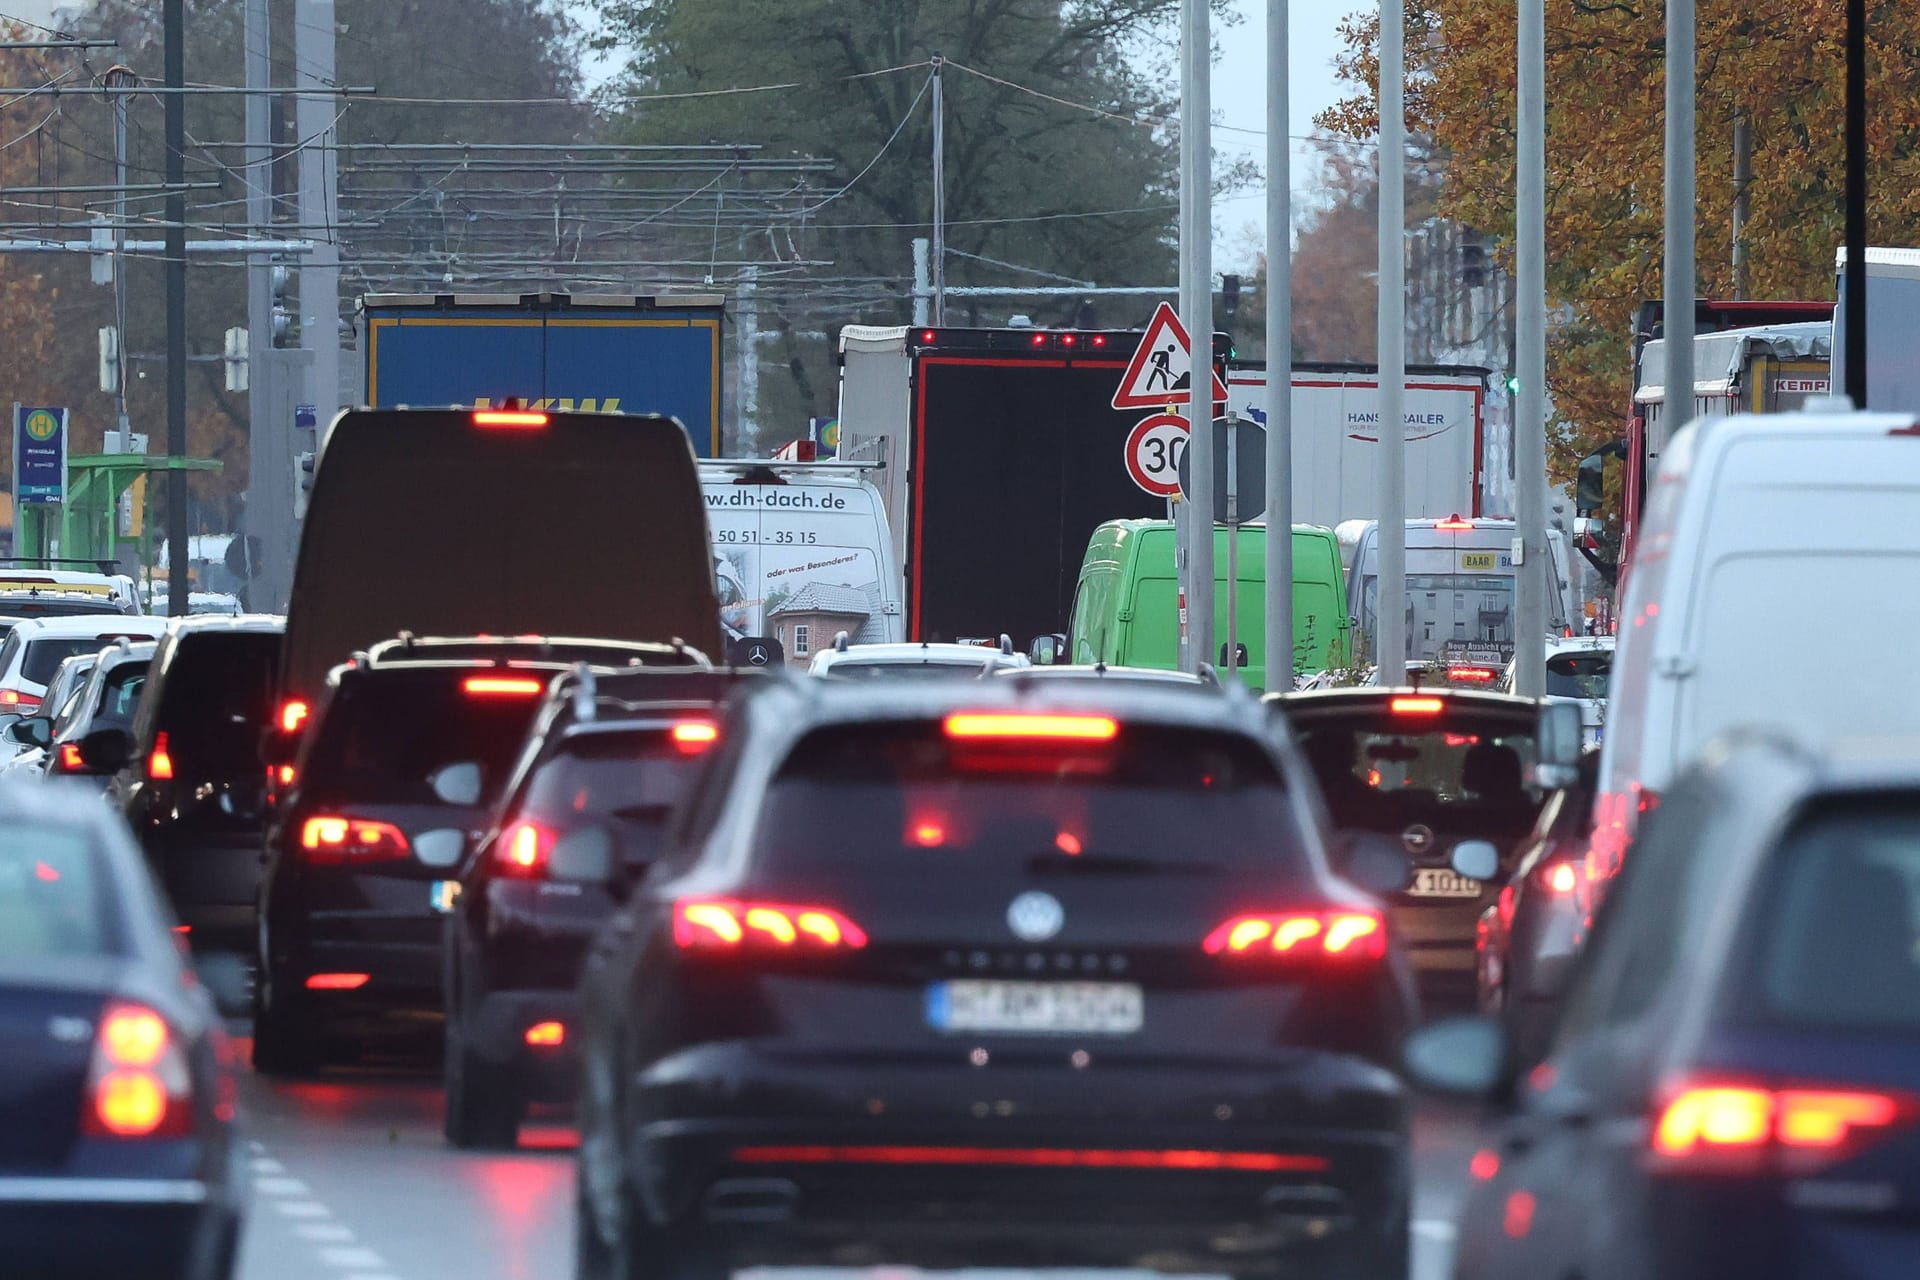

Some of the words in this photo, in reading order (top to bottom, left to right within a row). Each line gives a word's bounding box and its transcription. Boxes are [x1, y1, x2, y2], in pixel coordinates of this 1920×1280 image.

[1144, 436, 1186, 473] 30
[703, 489, 846, 510] w.dh-dach.de
[718, 530, 736, 542] 50
[742, 530, 757, 543] 51
[776, 531, 793, 543] 35
[800, 532, 816, 544] 15
[767, 568, 787, 578] oder
[788, 565, 805, 574] was
[807, 553, 858, 570] Besonderes?
[1466, 556, 1489, 566] BAAR
[1501, 557, 1512, 567] BA
[1500, 644, 1514, 653] ges
